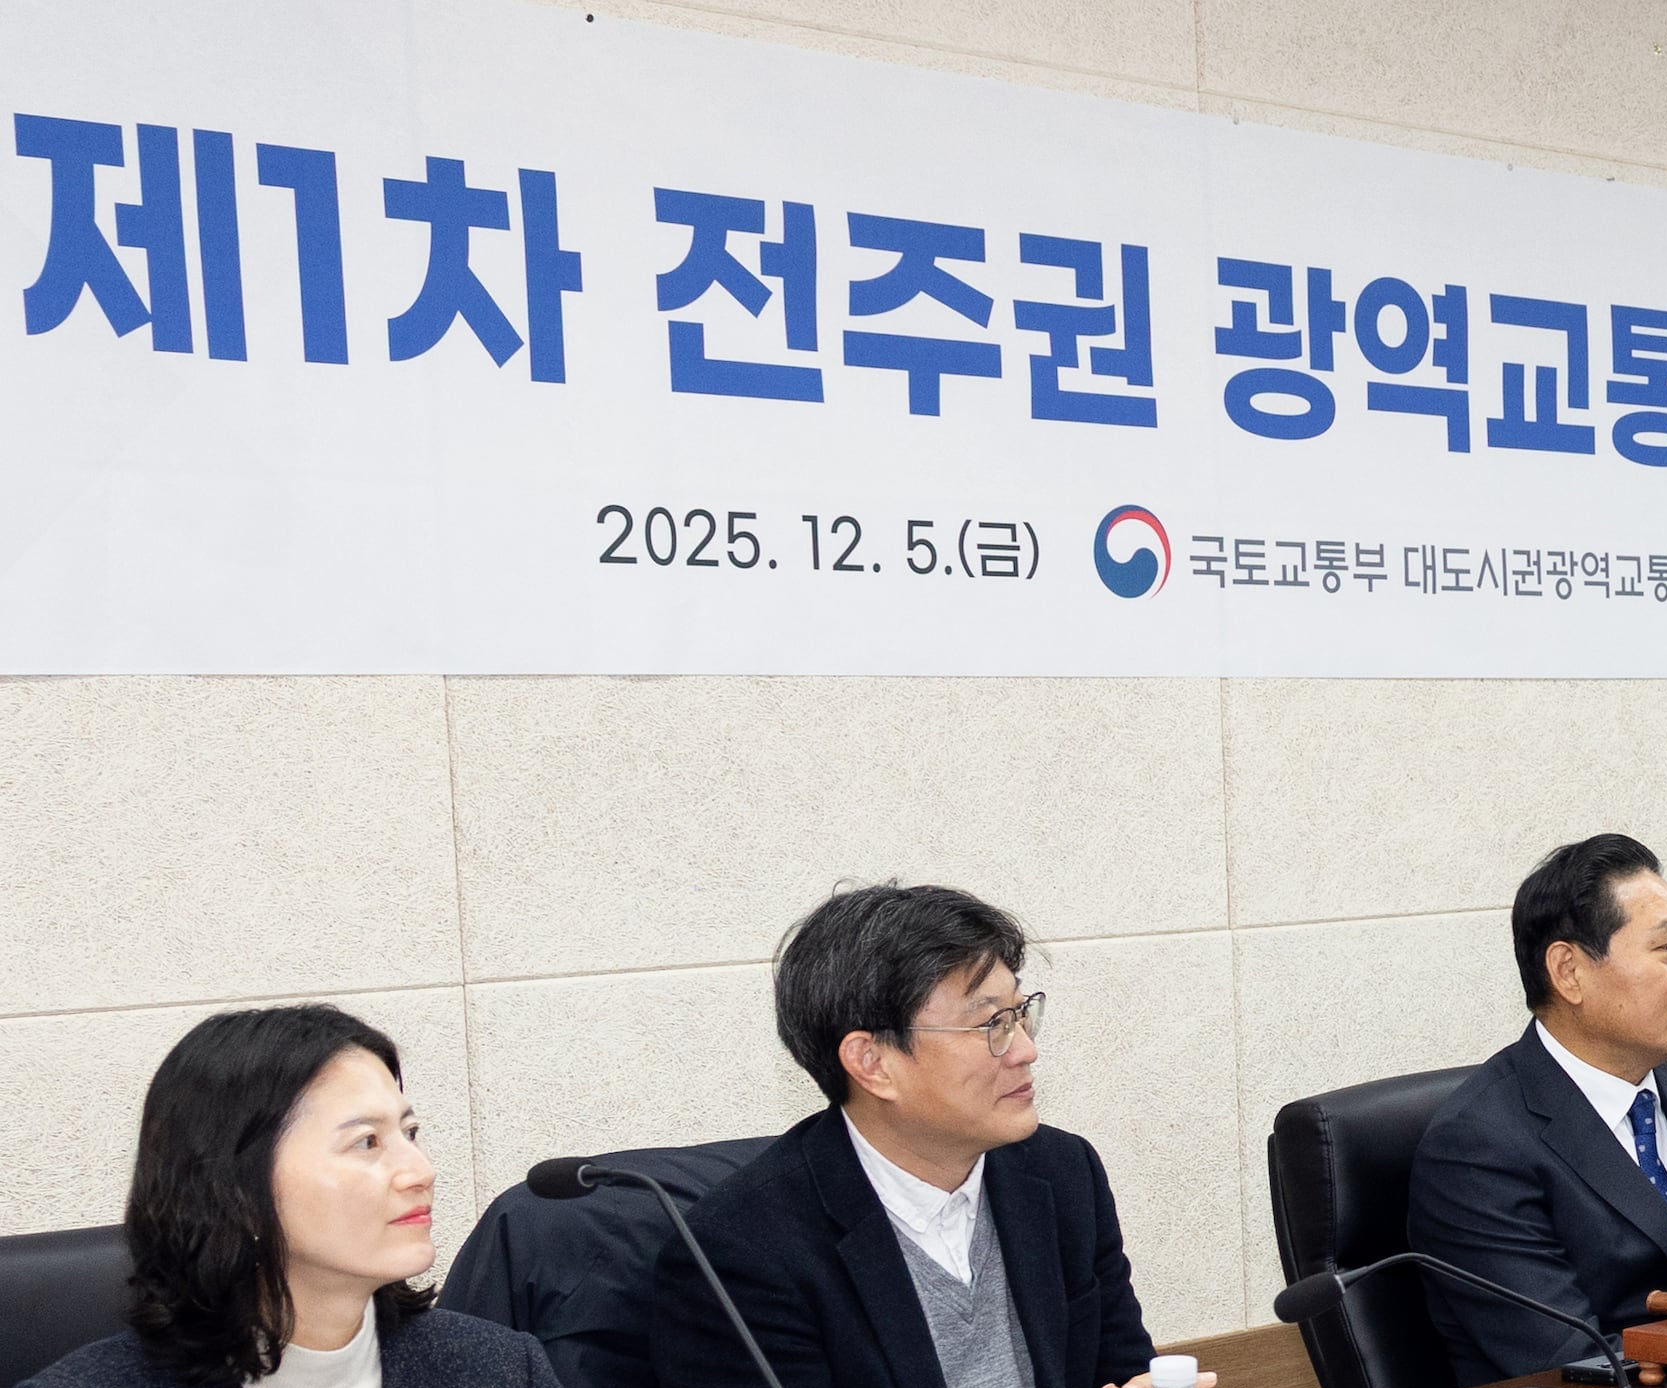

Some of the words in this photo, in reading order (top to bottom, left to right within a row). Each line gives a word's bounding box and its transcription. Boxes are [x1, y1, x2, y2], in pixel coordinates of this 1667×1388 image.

[15, 113, 583, 384] 제1차
[653, 187, 1158, 429] 전주권
[597, 503, 778, 570] 2025.
[801, 513, 882, 574] 12.
[906, 518, 1041, 580] 5.(금)
[1189, 534, 1388, 595] 국토교통부
